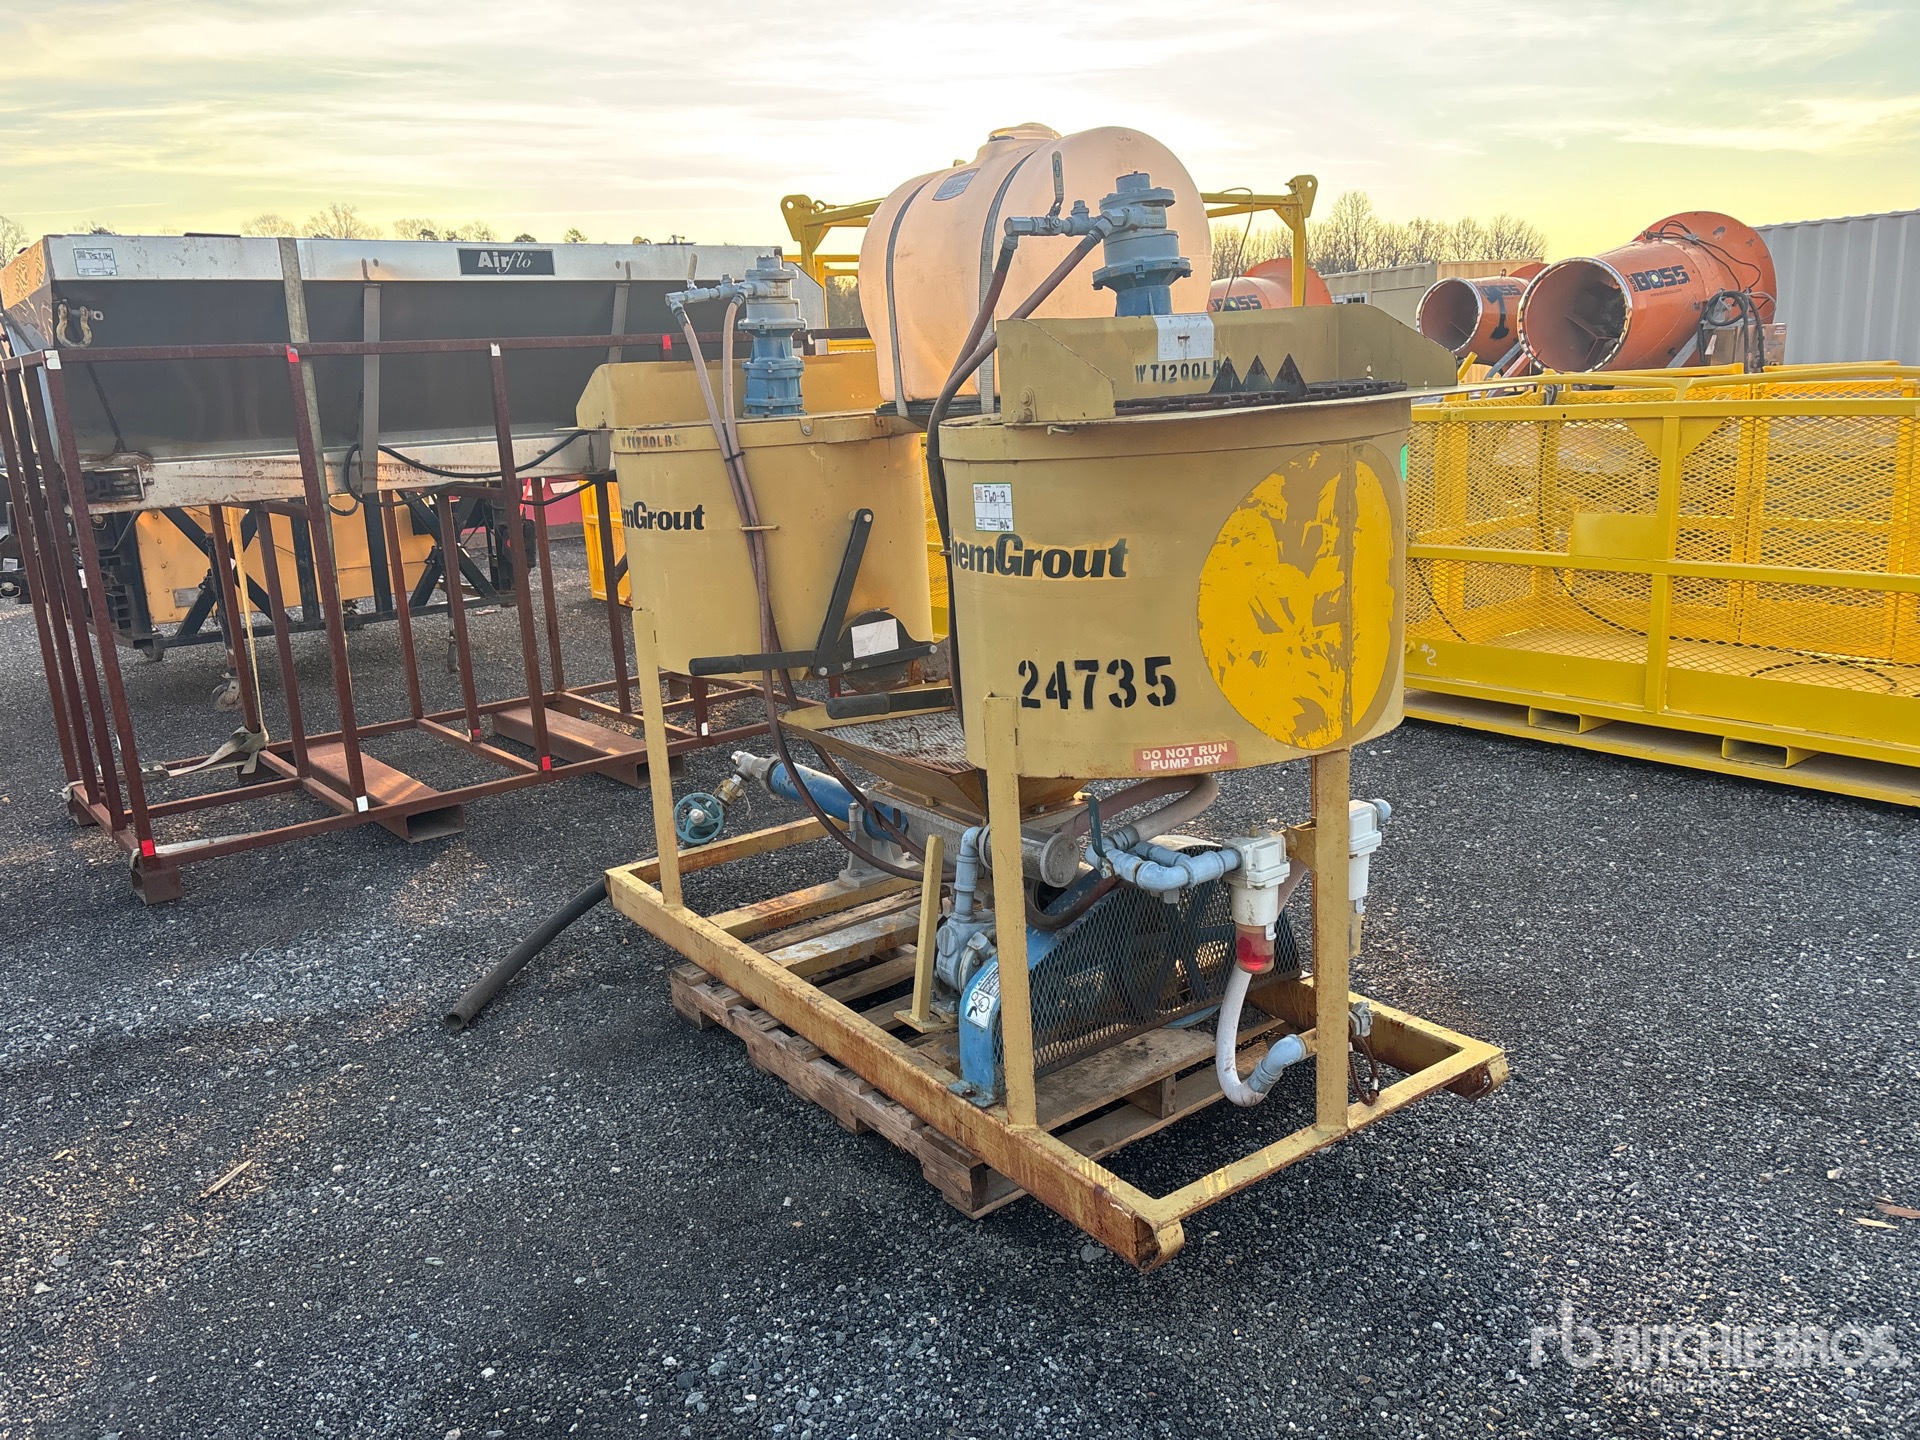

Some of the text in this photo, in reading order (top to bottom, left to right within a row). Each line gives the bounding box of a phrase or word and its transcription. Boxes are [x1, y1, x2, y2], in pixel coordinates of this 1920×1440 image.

[477, 251, 532, 274] Airflo
[1631, 265, 1691, 291] BOSS
[1018, 656, 1176, 709] 24735
[1142, 742, 1228, 760] DO NOT RUN
[1150, 754, 1222, 770] PUMP DRY
